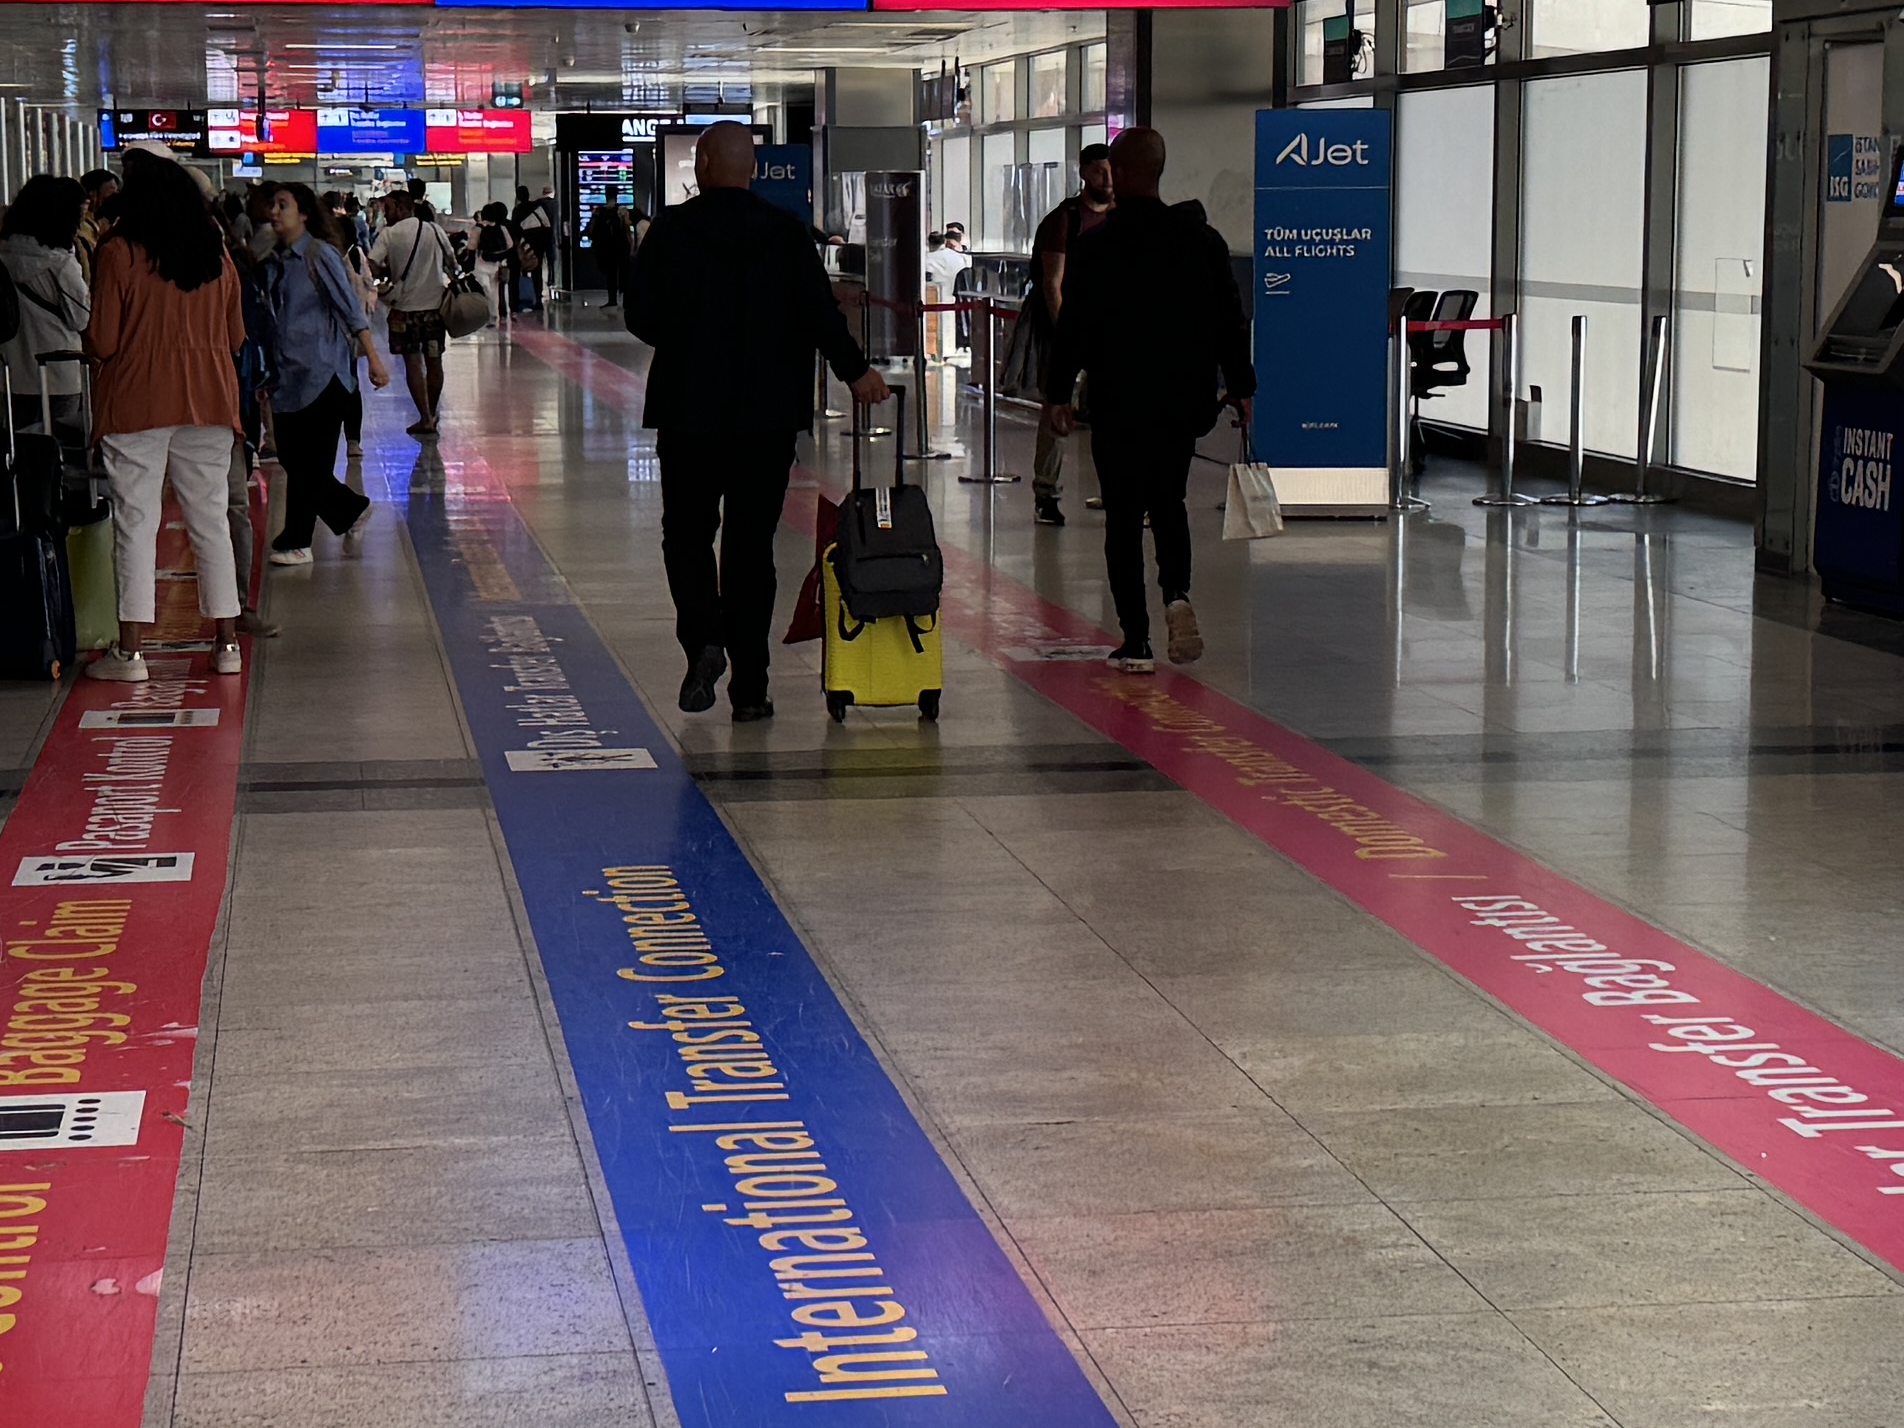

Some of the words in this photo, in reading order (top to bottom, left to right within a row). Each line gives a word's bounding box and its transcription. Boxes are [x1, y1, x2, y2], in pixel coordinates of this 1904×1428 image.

[751, 161, 796, 181] Jet
[1275, 132, 1370, 166] AJet
[1264, 226, 1297, 241] TÜM
[1301, 227, 1372, 244] UÇUŞLAR
[1264, 244, 1291, 257] ALL
[1294, 244, 1356, 258] FLIGHTS
[1843, 427, 1894, 461] INSTANT
[1840, 457, 1892, 512] CASH
[81, 735, 174, 782] Kontrol
[55, 783, 183, 851] Pasaport
[1259, 785, 1450, 861] Domestic
[4, 898, 133, 961] Claim
[580, 864, 725, 983] Connection
[1451, 892, 1702, 1009] Bağlantısı
[626, 993, 791, 1110] Transfer
[667, 1120, 949, 1403] International
